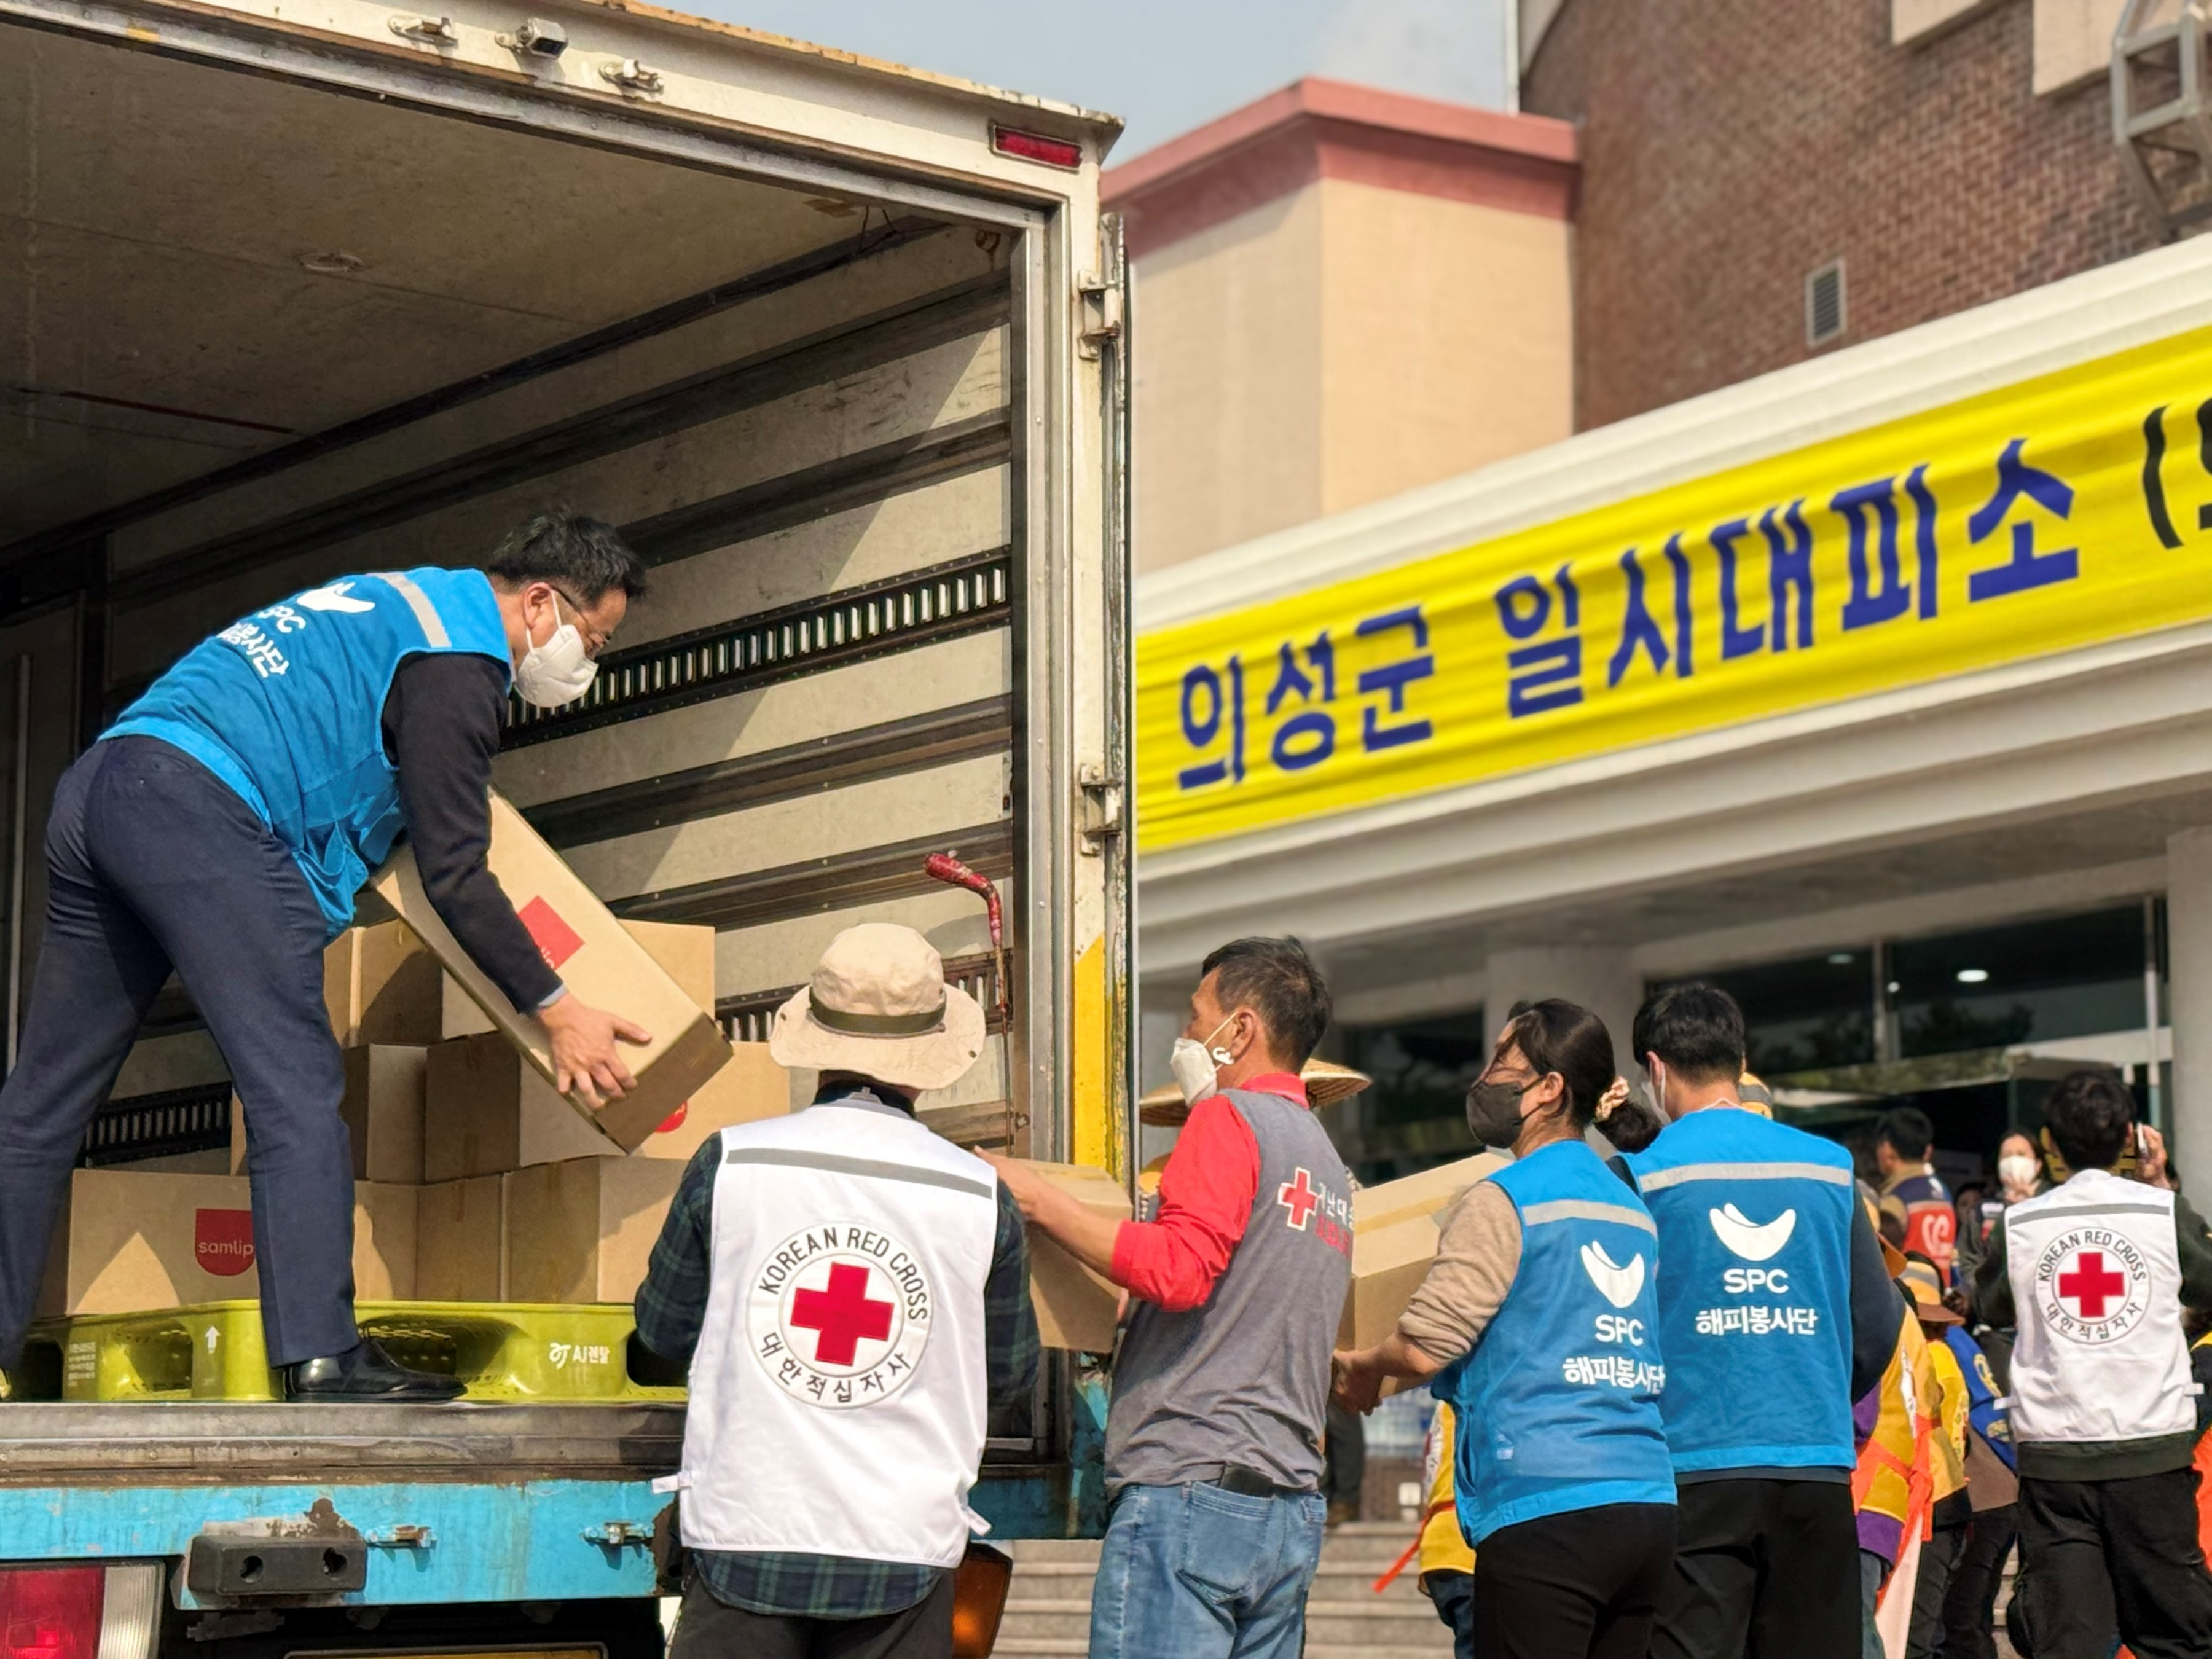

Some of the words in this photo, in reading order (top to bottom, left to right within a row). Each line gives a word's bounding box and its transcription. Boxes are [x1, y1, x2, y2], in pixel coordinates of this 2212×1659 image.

[1177, 605, 1434, 790] 의성군
[1494, 439, 2079, 718] 일시대피소
[198, 1239, 254, 1259] samlip
[2038, 1233, 2081, 1282] KOREAN
[2084, 1230, 2112, 1246] RED
[2113, 1239, 2147, 1281] CROSS
[759, 1227, 839, 1295] KOREAN
[847, 1228, 890, 1258] RED
[889, 1253, 928, 1320] CROSS
[1722, 1269, 1789, 1293] SPC
[1594, 1314, 1644, 1346] SPC
[1695, 1305, 1819, 1335] 해피봉사단
[2047, 1301, 2143, 1340] 대한적십자사
[759, 1332, 912, 1403] 대한적십자사
[1562, 1355, 1666, 1395] 해피봉사단
